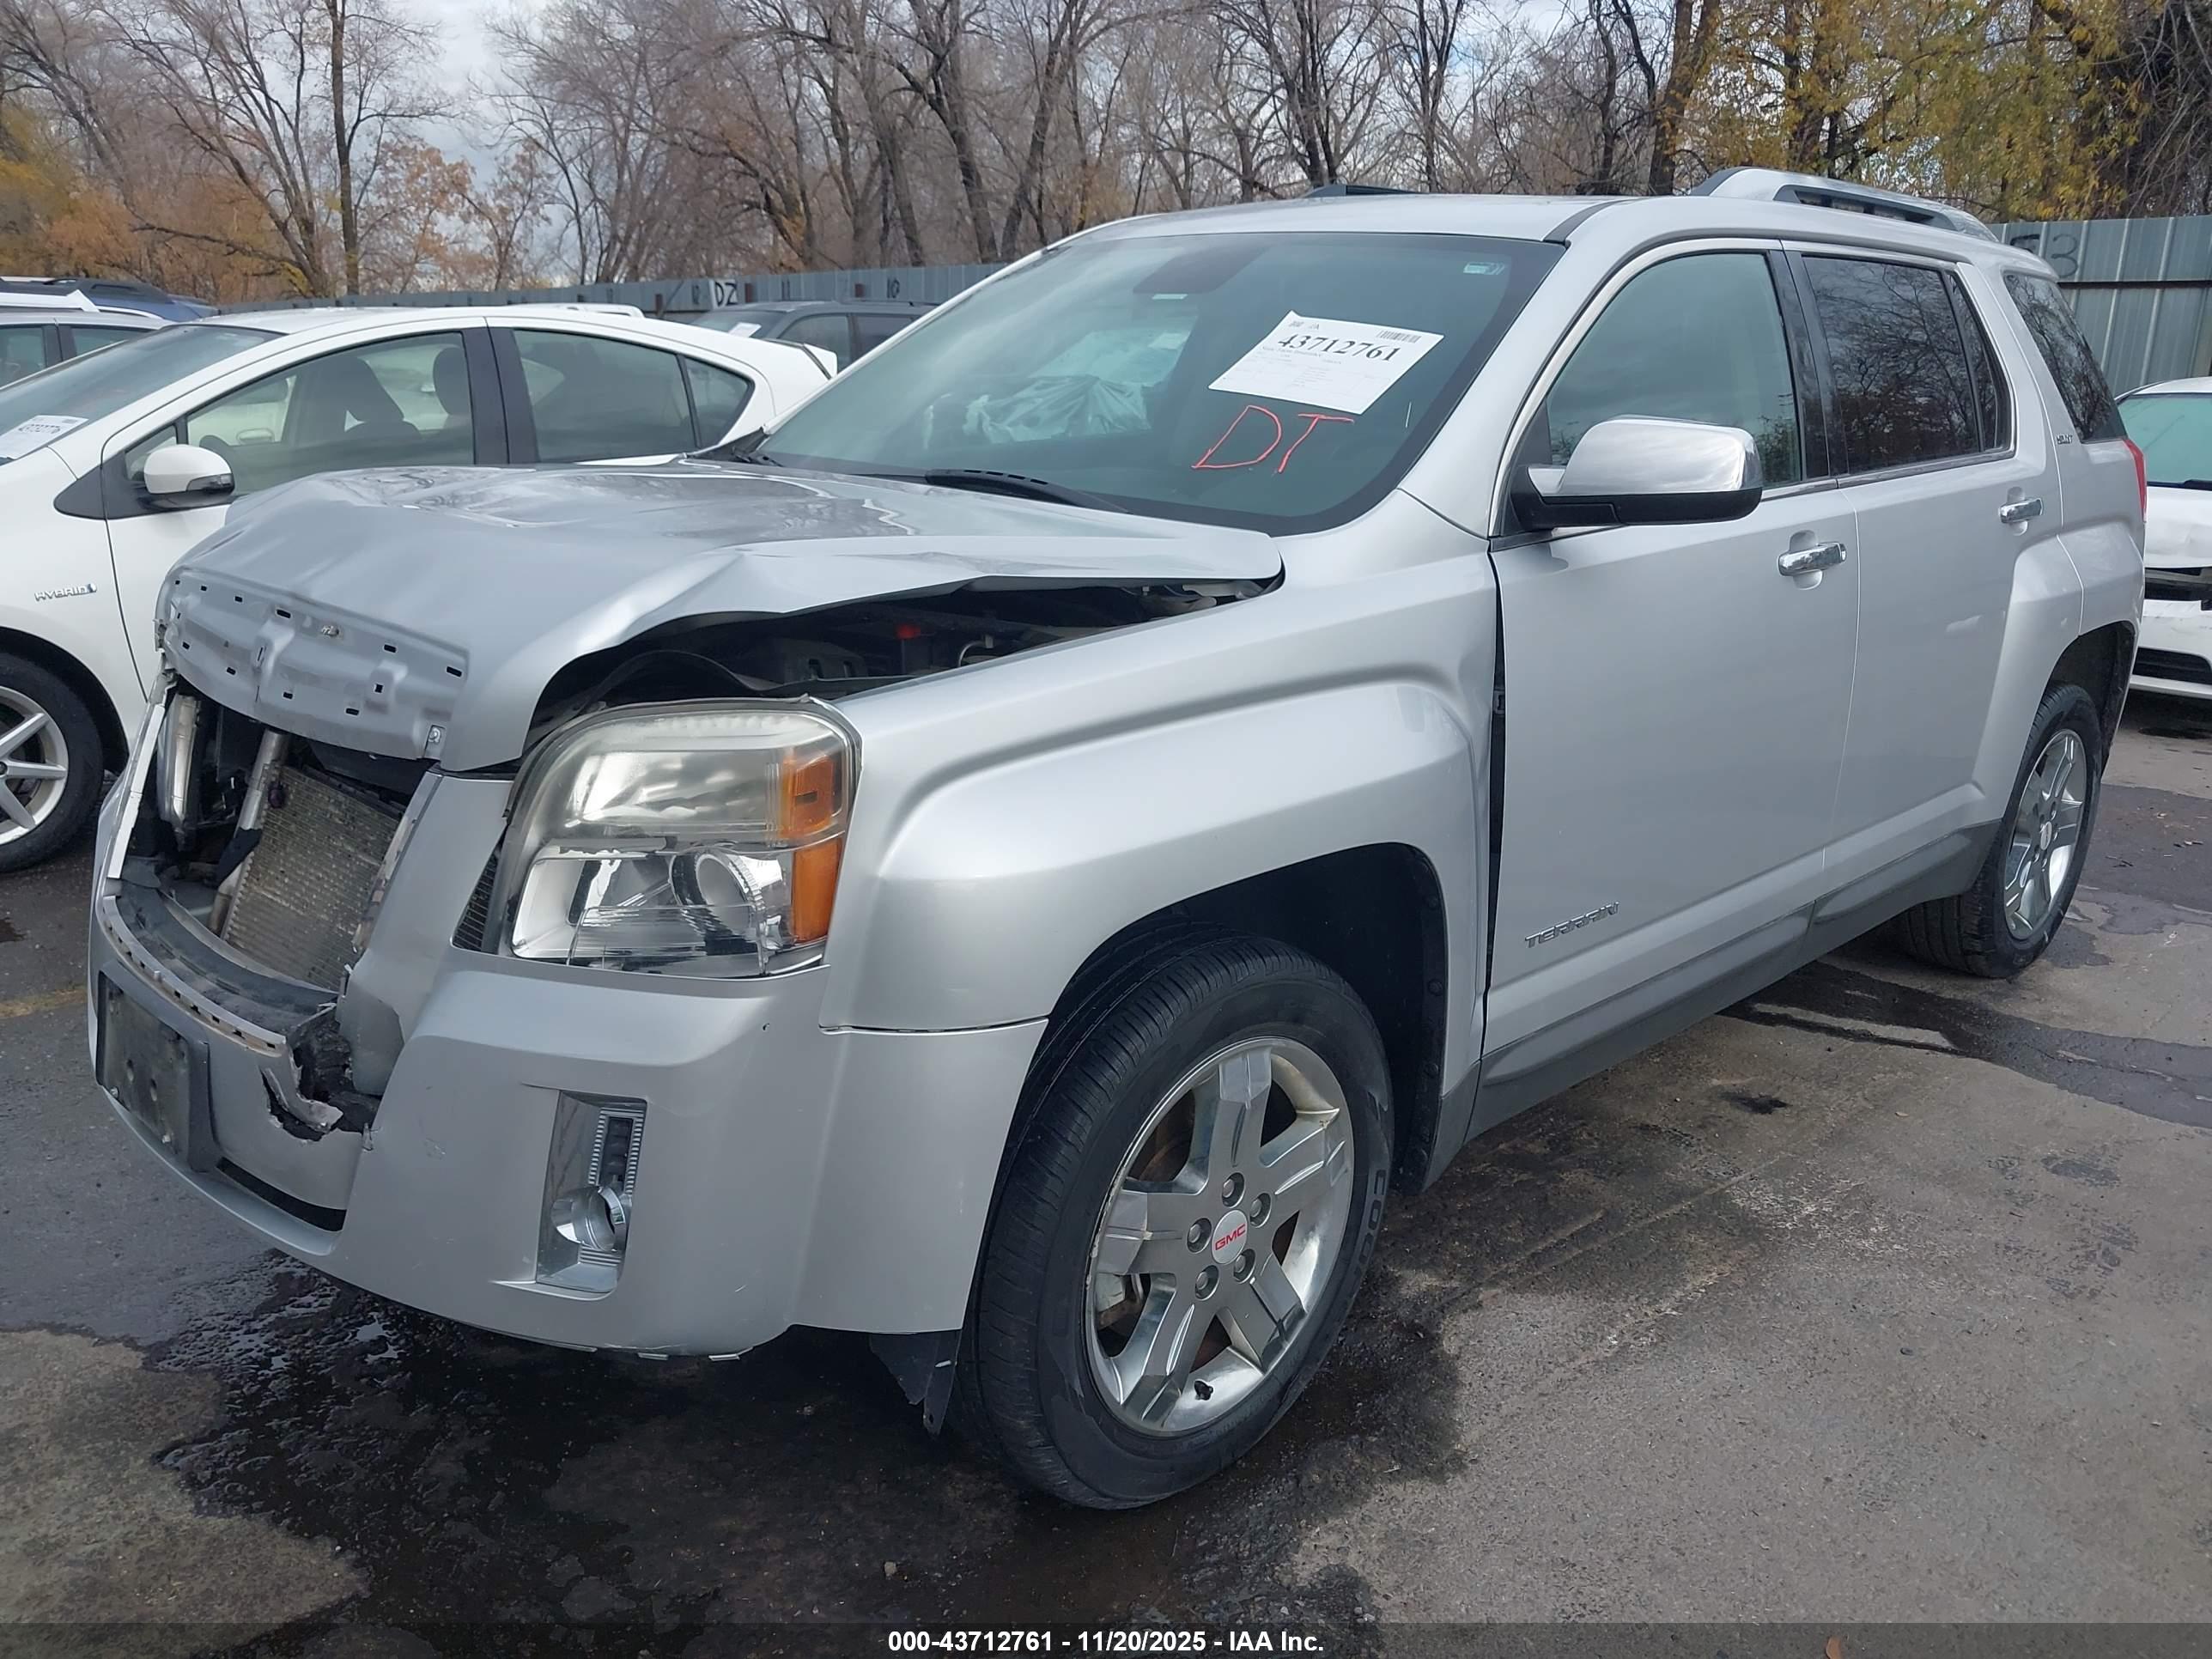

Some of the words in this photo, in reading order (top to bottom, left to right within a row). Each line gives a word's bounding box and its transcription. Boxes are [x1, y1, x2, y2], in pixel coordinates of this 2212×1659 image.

[1278, 333, 1401, 362] 43712761
[1191, 404, 1355, 473] DT
[34, 585, 88, 602] HYBRID
[1525, 901, 1620, 948] TERRAIN
[1215, 1223, 1246, 1251] GMC
